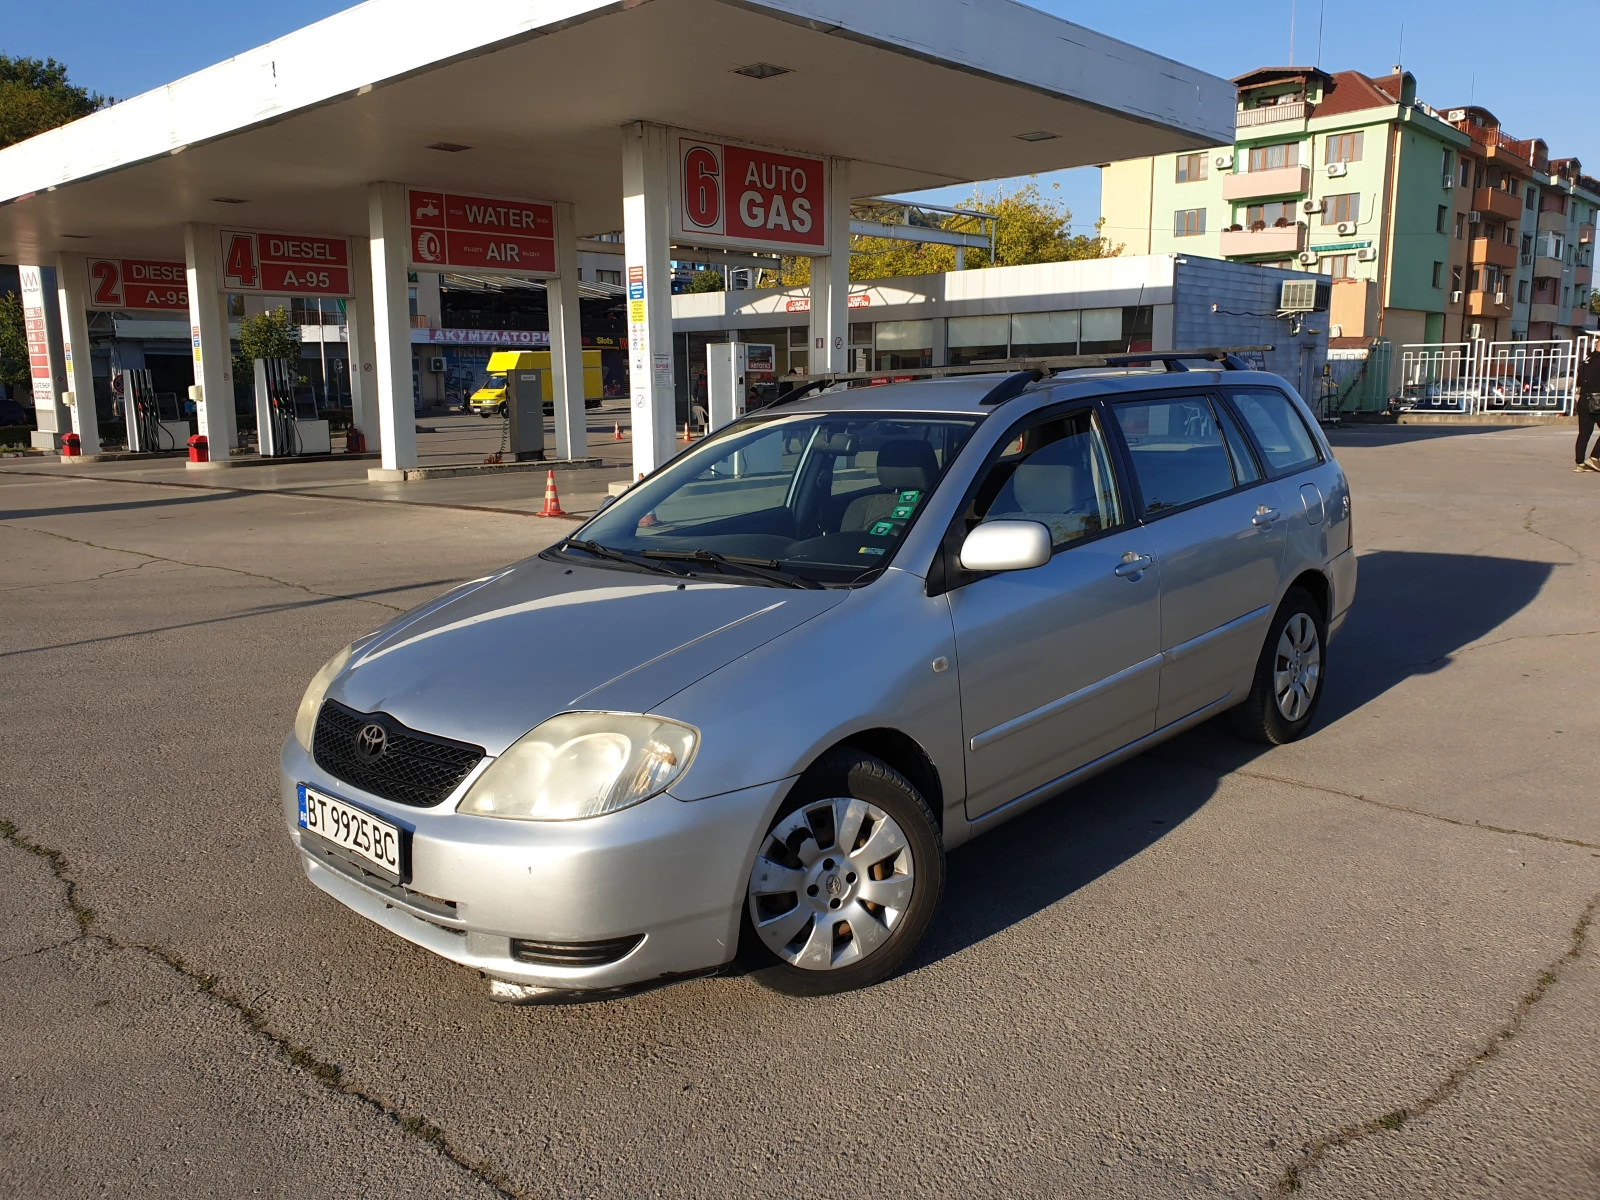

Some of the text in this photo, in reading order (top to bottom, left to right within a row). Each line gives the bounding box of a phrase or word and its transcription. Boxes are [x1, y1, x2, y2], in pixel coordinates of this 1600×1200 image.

[684, 146, 720, 228] 6
[744, 160, 807, 194] AUTO
[465, 204, 536, 229] WATER
[739, 190, 813, 234] GAS
[226, 234, 258, 286] 4
[269, 239, 337, 260] DIESEL
[486, 241, 520, 262] AIR
[92, 260, 120, 304] 2
[283, 269, 330, 288] A-95
[145, 290, 188, 305] A-95
[596, 336, 614, 345] Slots
[300, 811, 307, 822] BG
[308, 794, 396, 867] BT 9925 BC
